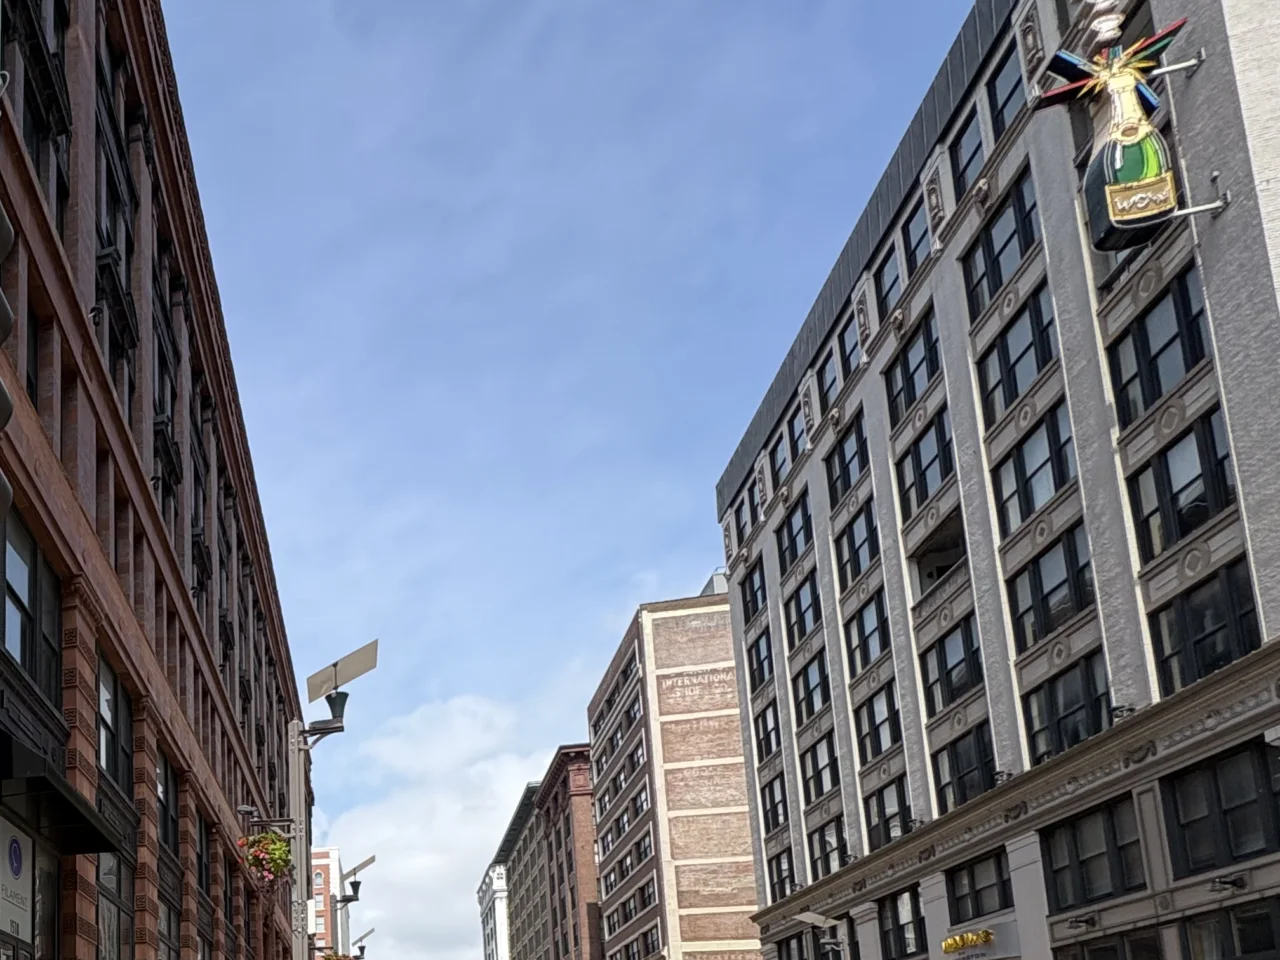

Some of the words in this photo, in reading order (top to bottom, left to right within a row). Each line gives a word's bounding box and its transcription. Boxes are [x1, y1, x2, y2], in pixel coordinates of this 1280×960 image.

[1114, 187, 1170, 210] WOW
[661, 672, 735, 688] INTERNATIONA
[1, 883, 28, 909] FILAMENT
